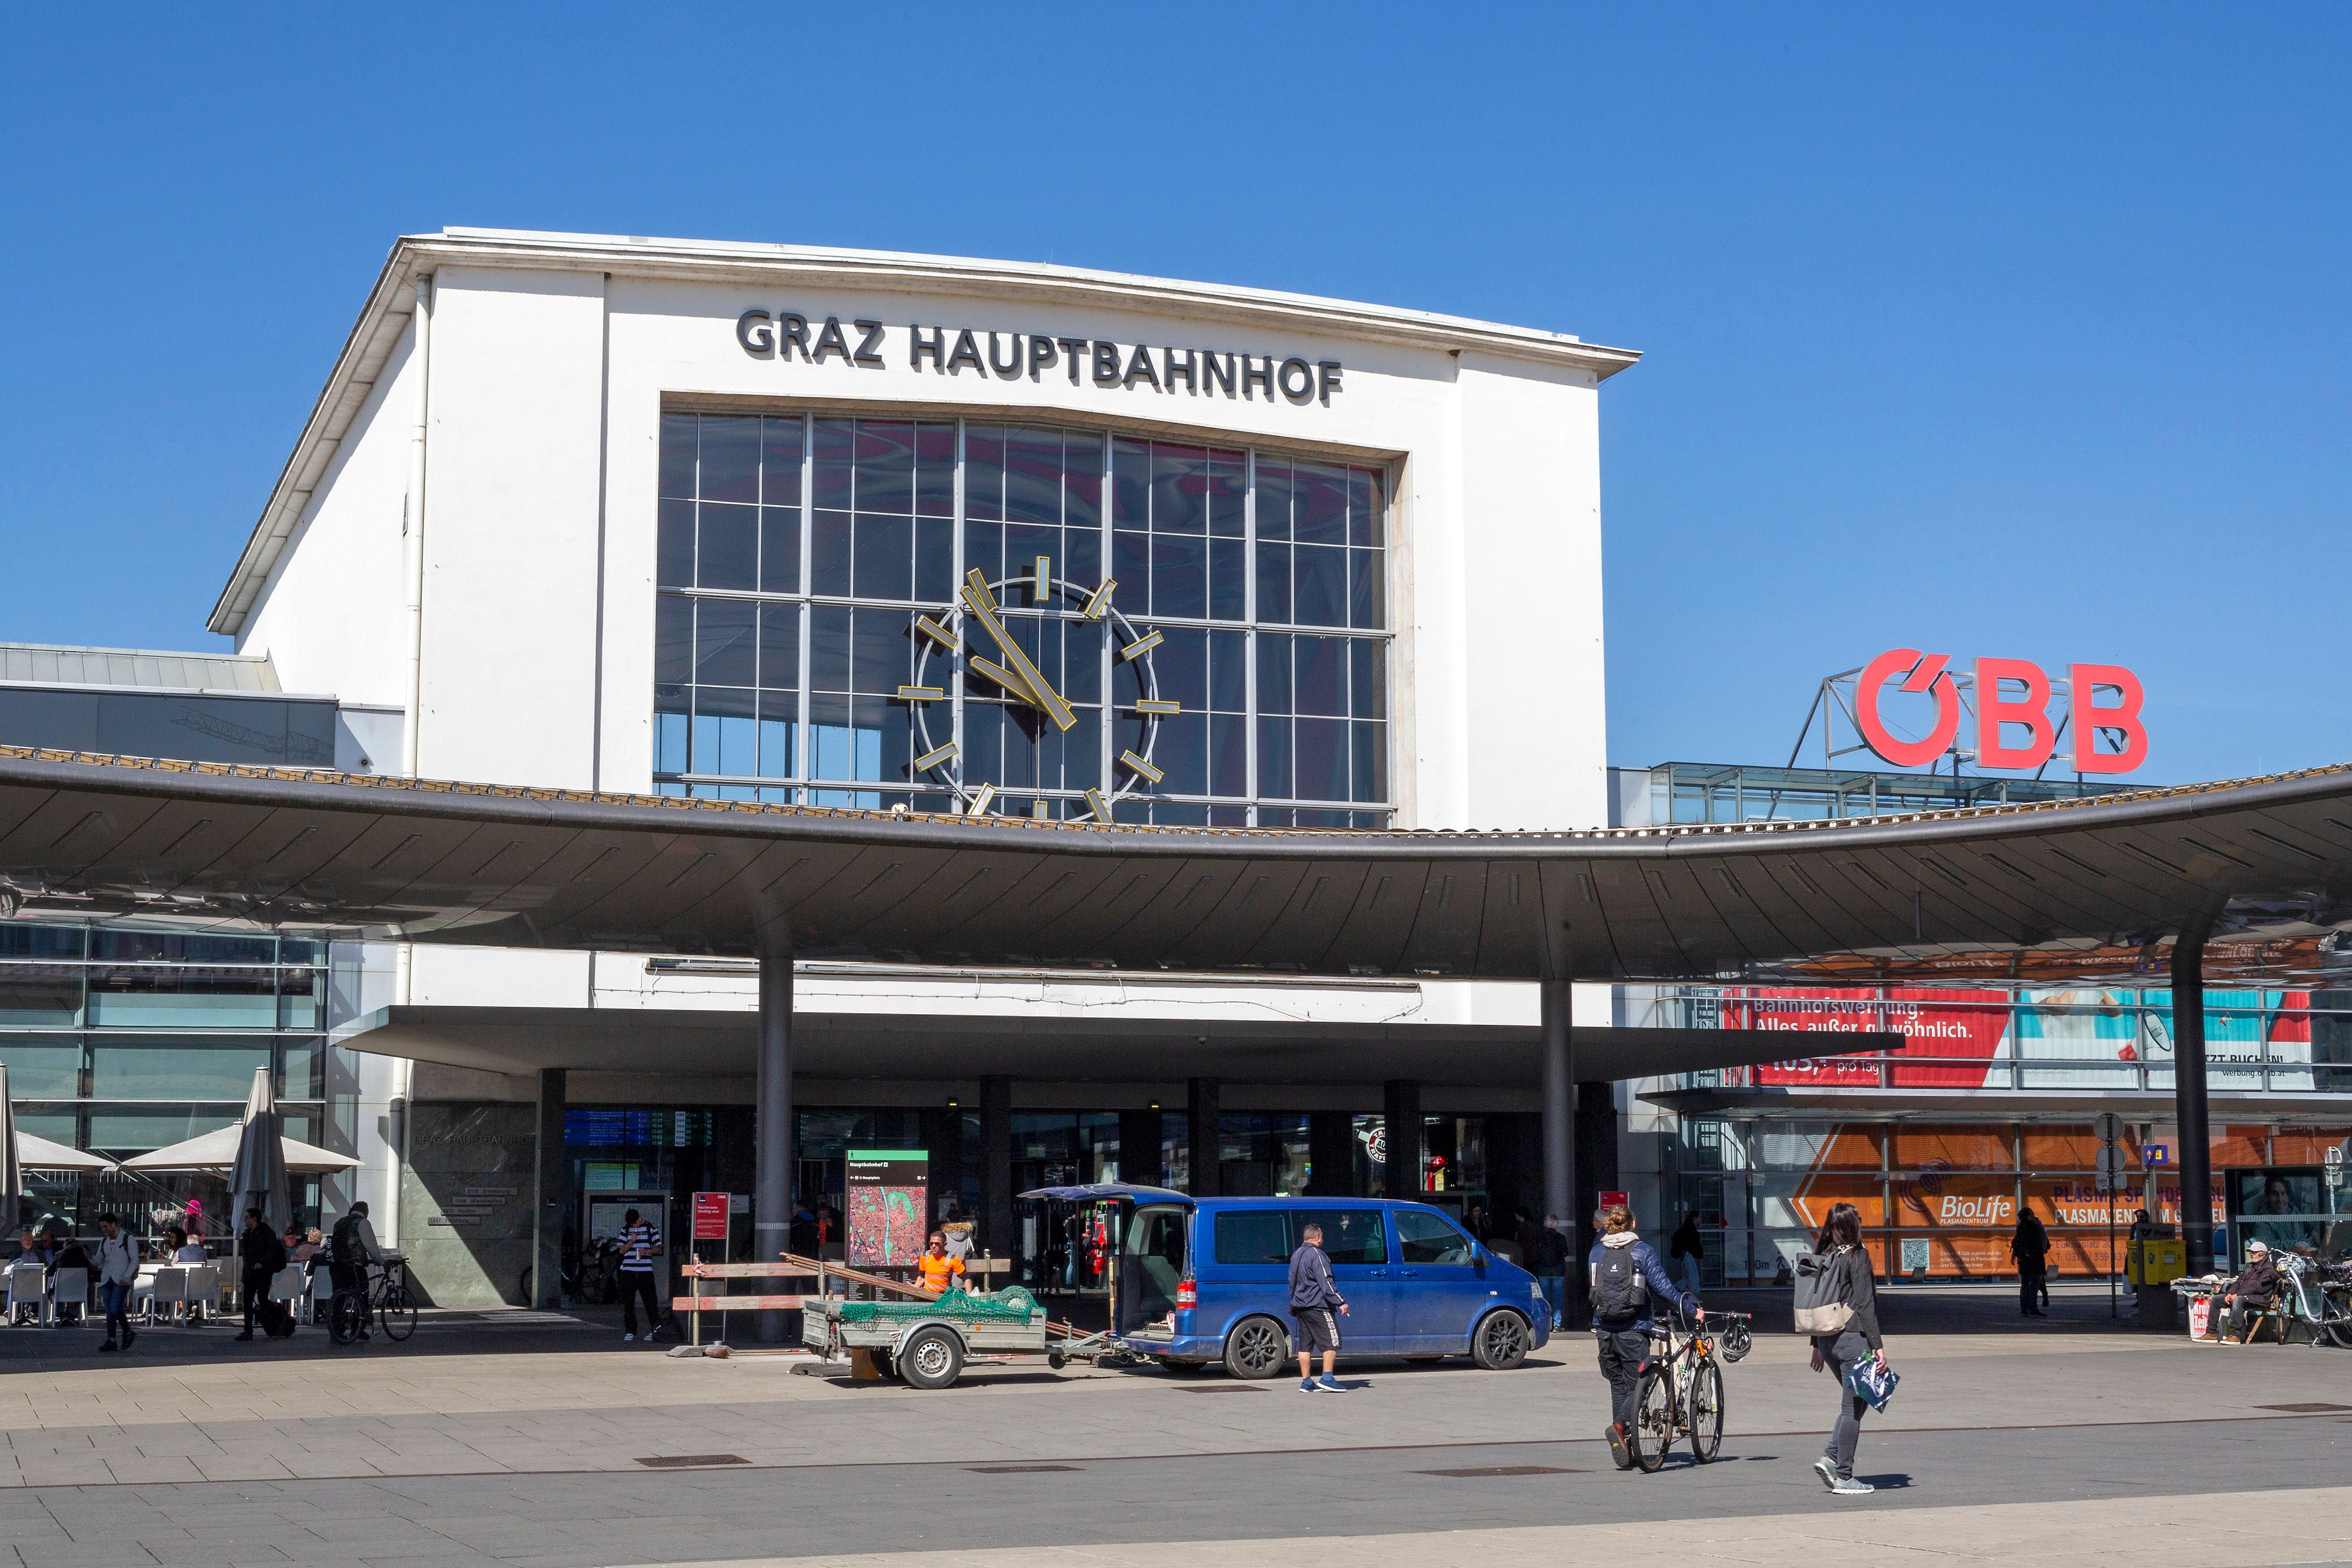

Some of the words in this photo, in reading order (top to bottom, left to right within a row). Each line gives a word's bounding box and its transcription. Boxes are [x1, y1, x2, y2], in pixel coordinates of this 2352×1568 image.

[737, 310, 882, 363] GRAZ
[910, 325, 1341, 400] HAUPTBAHNHOF
[1852, 648, 2149, 774] ÖBB
[1756, 1018, 1798, 1031] Alles
[1808, 1018, 1858, 1032] außer
[1865, 1021, 1973, 1038] gwöhnlich.
[1837, 1061, 1856, 1075] pro
[1861, 1060, 1879, 1075] Tag
[2223, 1069, 2285, 1078] werbung.obb.at
[2054, 1186, 2118, 1203] PLASMA
[1941, 1195, 2011, 1223] BioLife
[2093, 1252, 2109, 1261] 339
